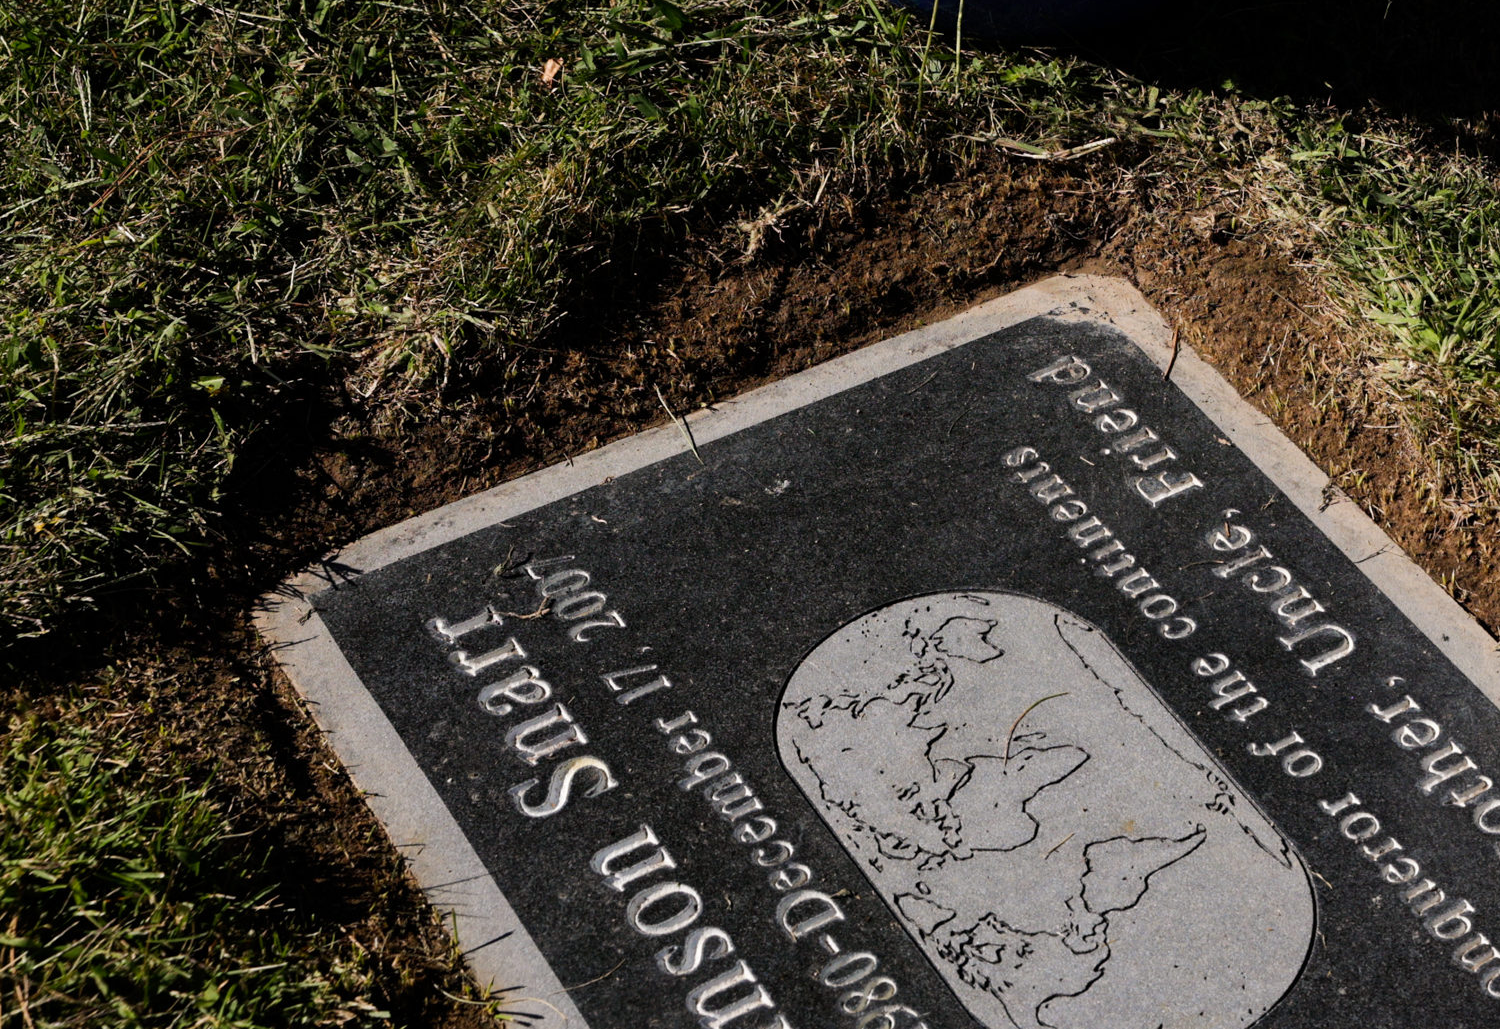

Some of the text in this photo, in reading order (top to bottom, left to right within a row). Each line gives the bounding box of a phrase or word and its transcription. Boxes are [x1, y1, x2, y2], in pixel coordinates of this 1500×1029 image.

[1027, 355, 1204, 507] Friend
[1004, 446, 1198, 640] continents
[1206, 508, 1355, 677] Uncle,
[1191, 652, 1270, 723] the
[1246, 730, 1324, 778] of
[425, 604, 793, 1029] nson Snarr
[524, 554, 929, 1029] 980-December 17, 2007
